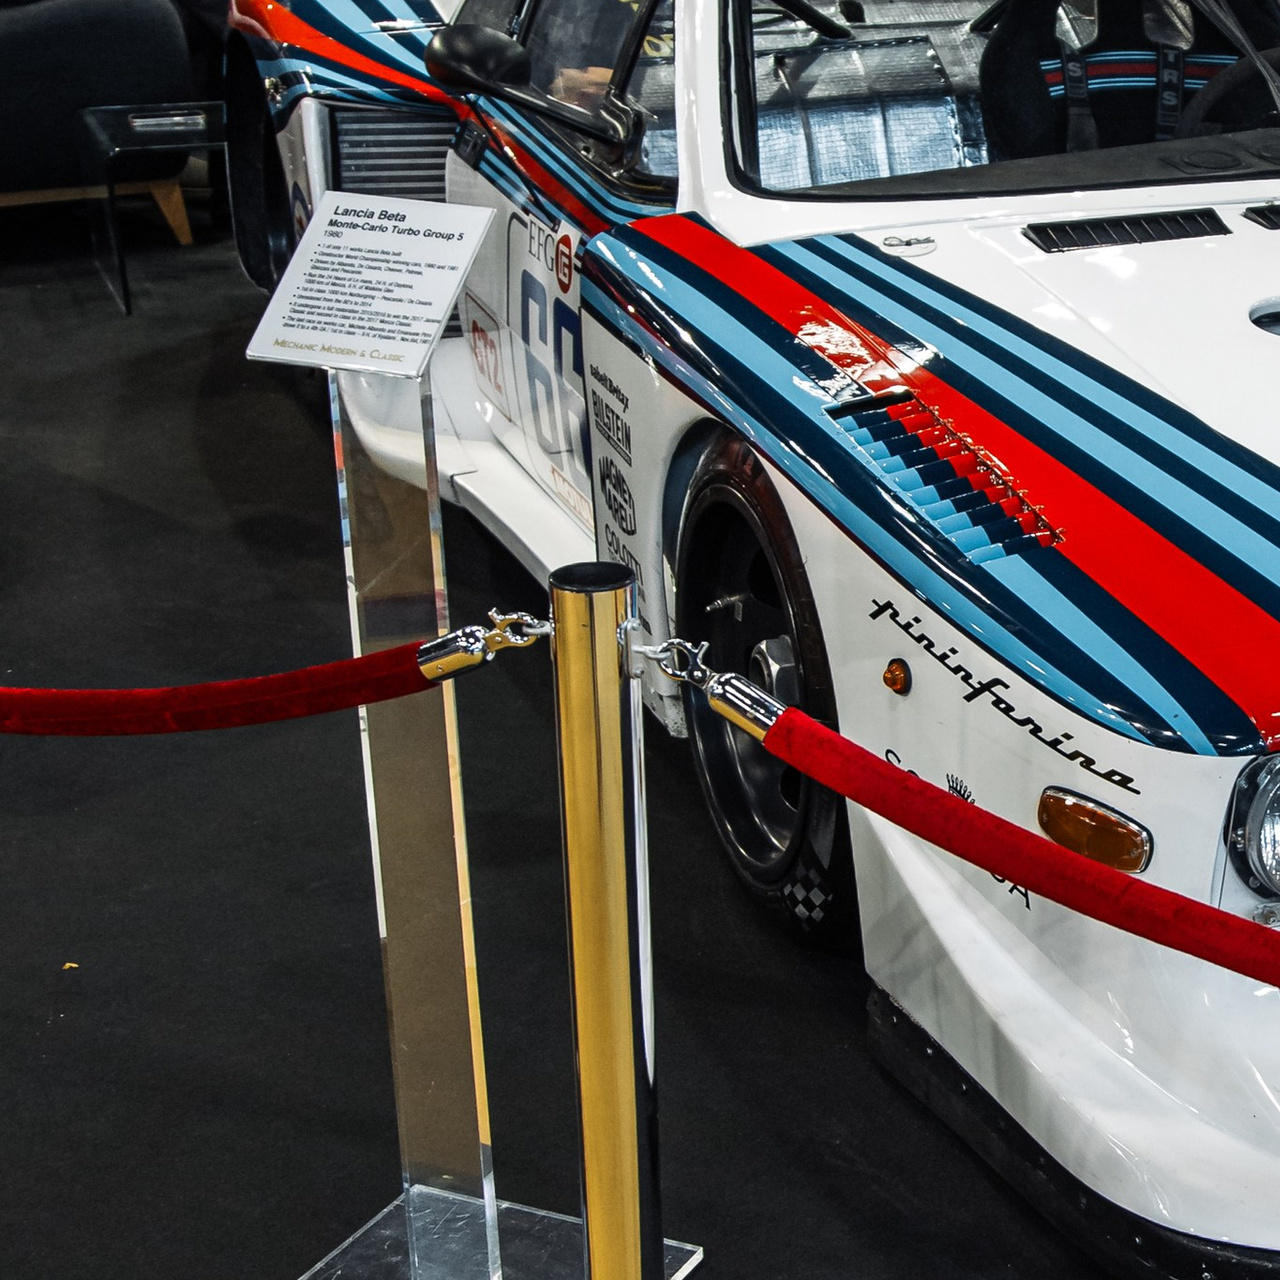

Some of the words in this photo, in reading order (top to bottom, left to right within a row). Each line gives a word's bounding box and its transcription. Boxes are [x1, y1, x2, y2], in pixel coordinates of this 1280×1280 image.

[333, 205, 375, 219] Lancia
[378, 210, 406, 222] Beta
[324, 230, 343, 238] 1980
[328, 218, 388, 233] Monte-Carlo
[391, 225, 420, 236] Turbo
[423, 230, 455, 242] Group
[456, 232, 464, 241] 5
[528, 219, 555, 272] EFG
[320, 344, 357, 356] MODERN
[370, 349, 405, 362] CLASSIC
[592, 388, 632, 455] BILSTEIN
[868, 598, 1142, 795] pininfarina
